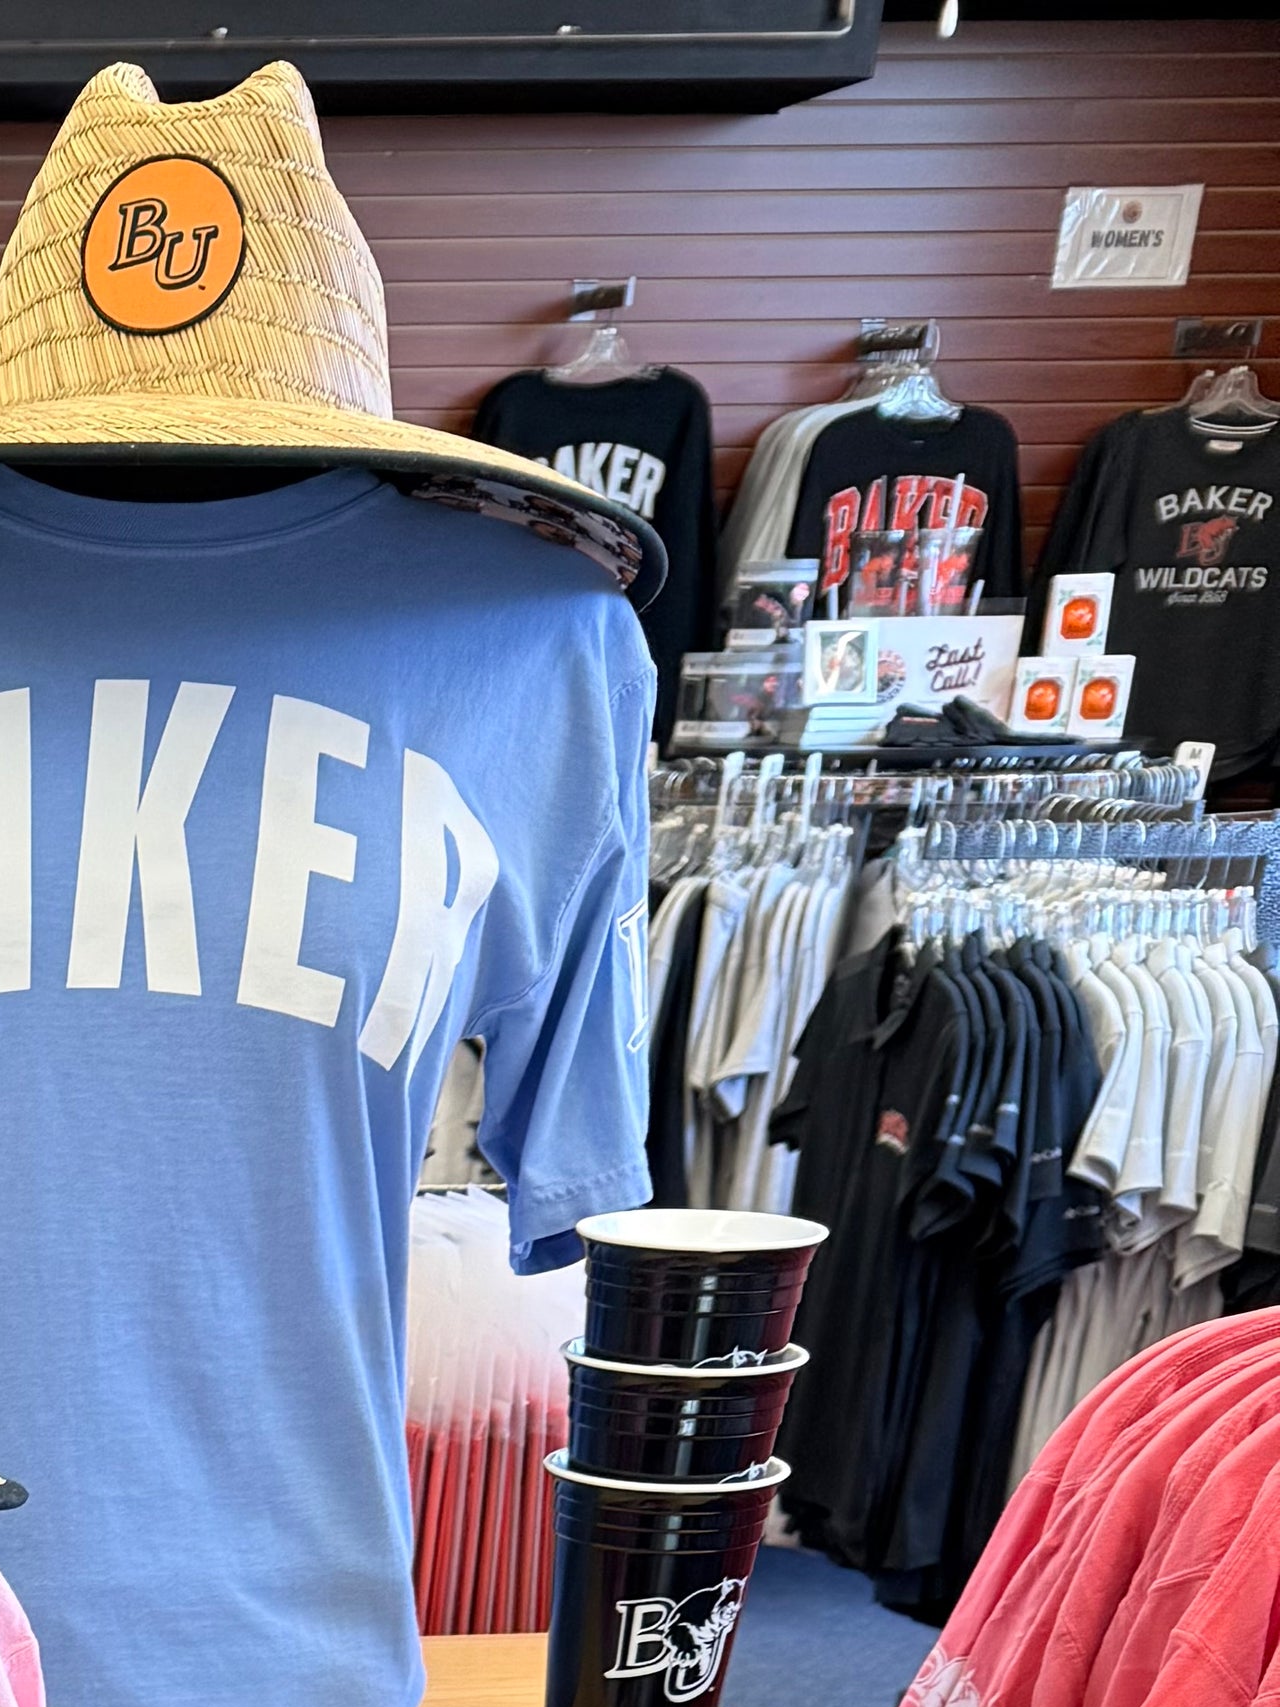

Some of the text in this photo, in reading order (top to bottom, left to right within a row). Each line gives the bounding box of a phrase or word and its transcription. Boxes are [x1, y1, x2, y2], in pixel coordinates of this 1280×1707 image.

[107, 198, 220, 290] BU
[1090, 229, 1165, 249] WOMEN'S
[534, 441, 666, 520] AKER
[1157, 485, 1274, 522] BAKER
[1138, 566, 1269, 590] WILDCATS
[925, 637, 986, 671] Last
[930, 663, 983, 693] Call!
[603, 1597, 735, 1704] BU
